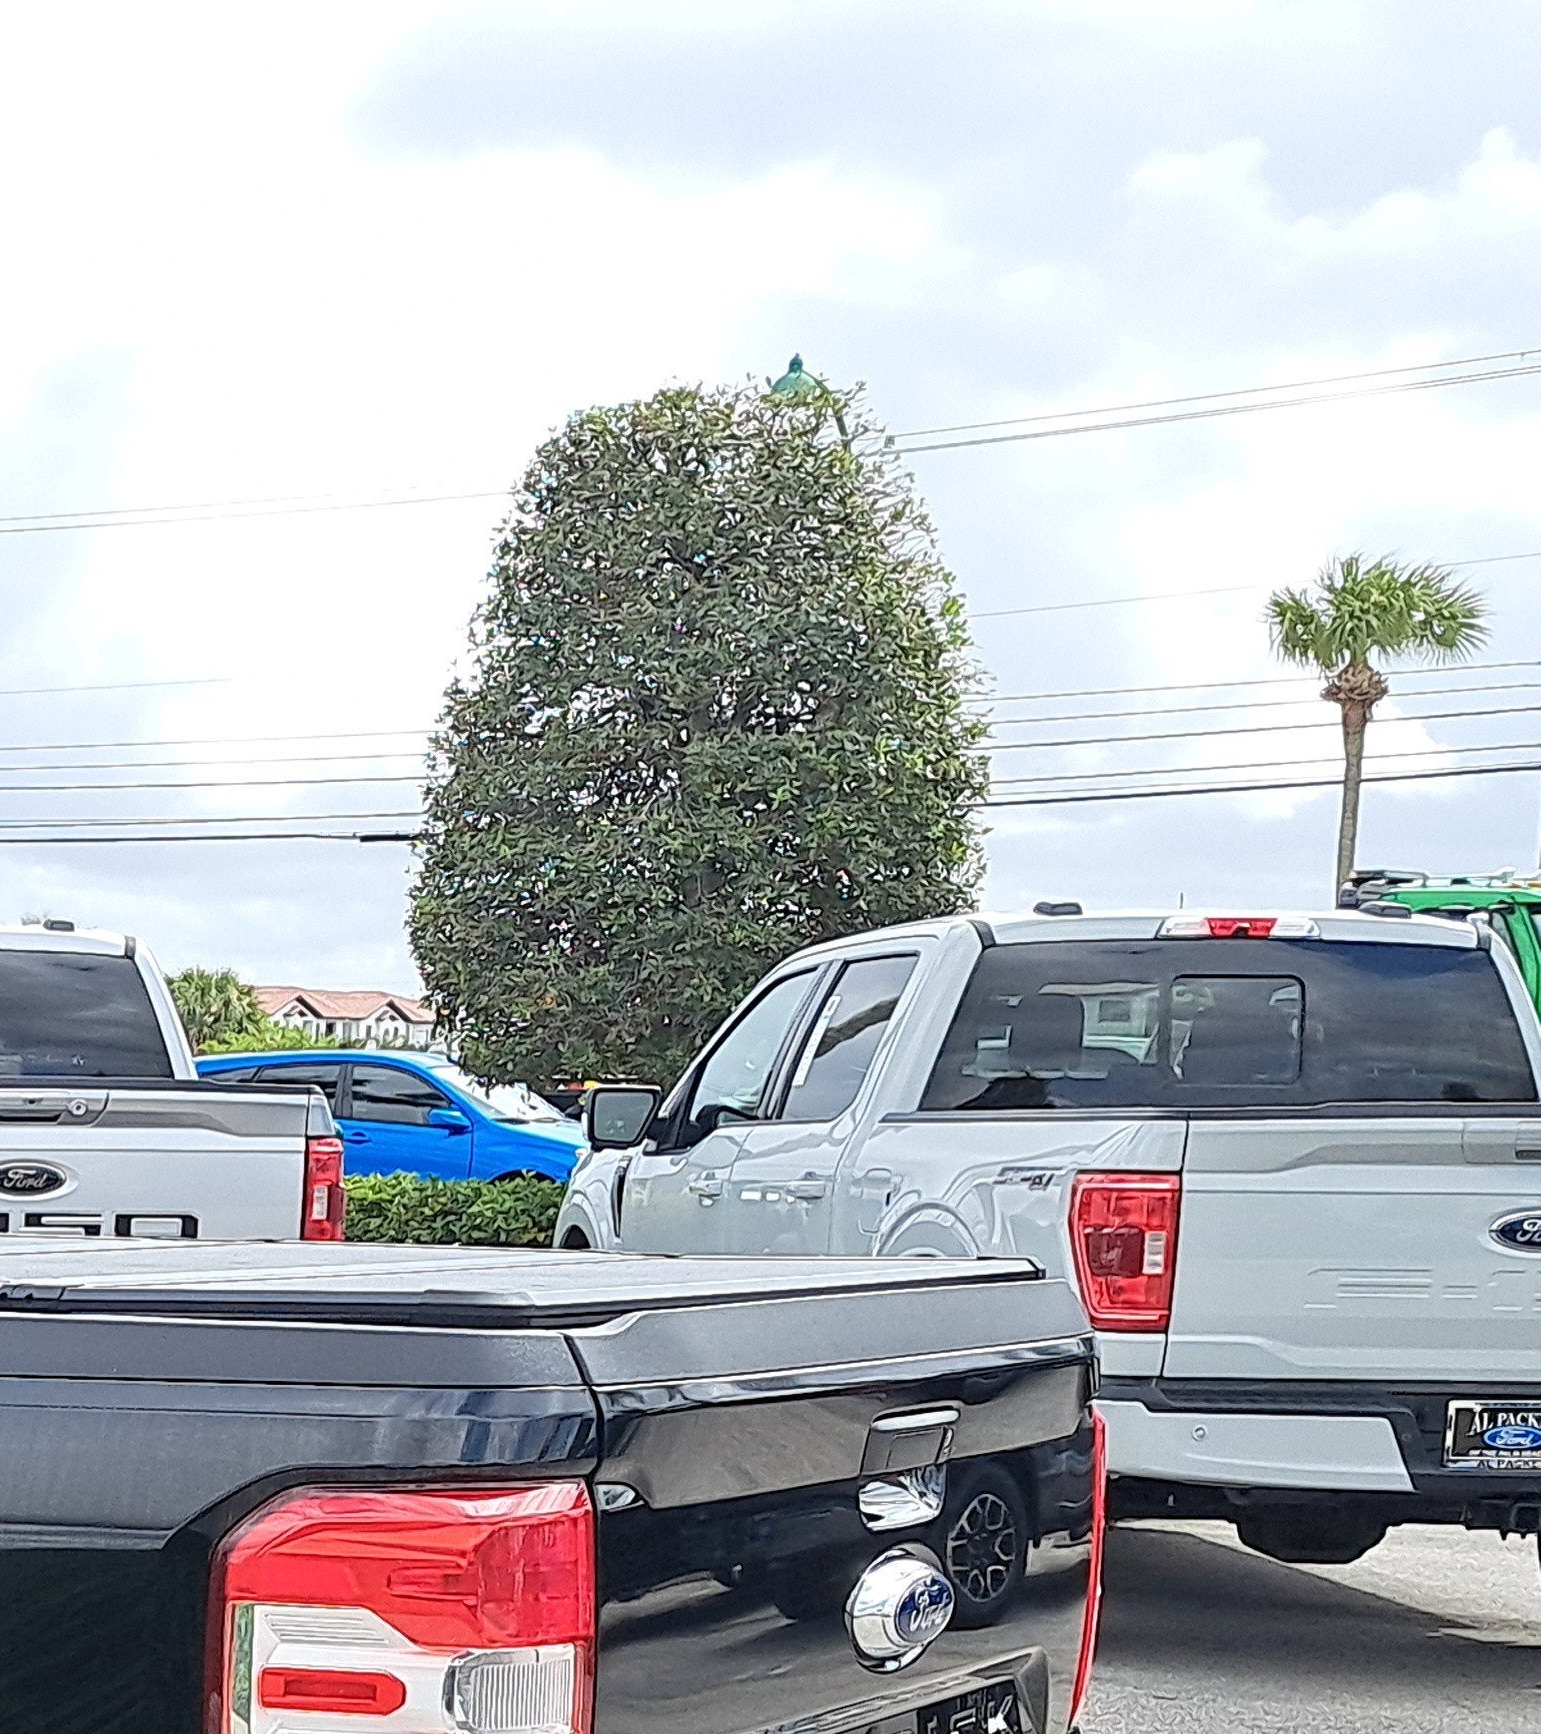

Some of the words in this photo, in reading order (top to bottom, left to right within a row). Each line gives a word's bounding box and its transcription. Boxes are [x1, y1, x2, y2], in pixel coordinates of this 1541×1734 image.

[4, 1168, 48, 1188] Ford
[1464, 1411, 1494, 1436] AL
[1497, 1411, 1541, 1429] PACK
[1496, 1429, 1535, 1446] Ford
